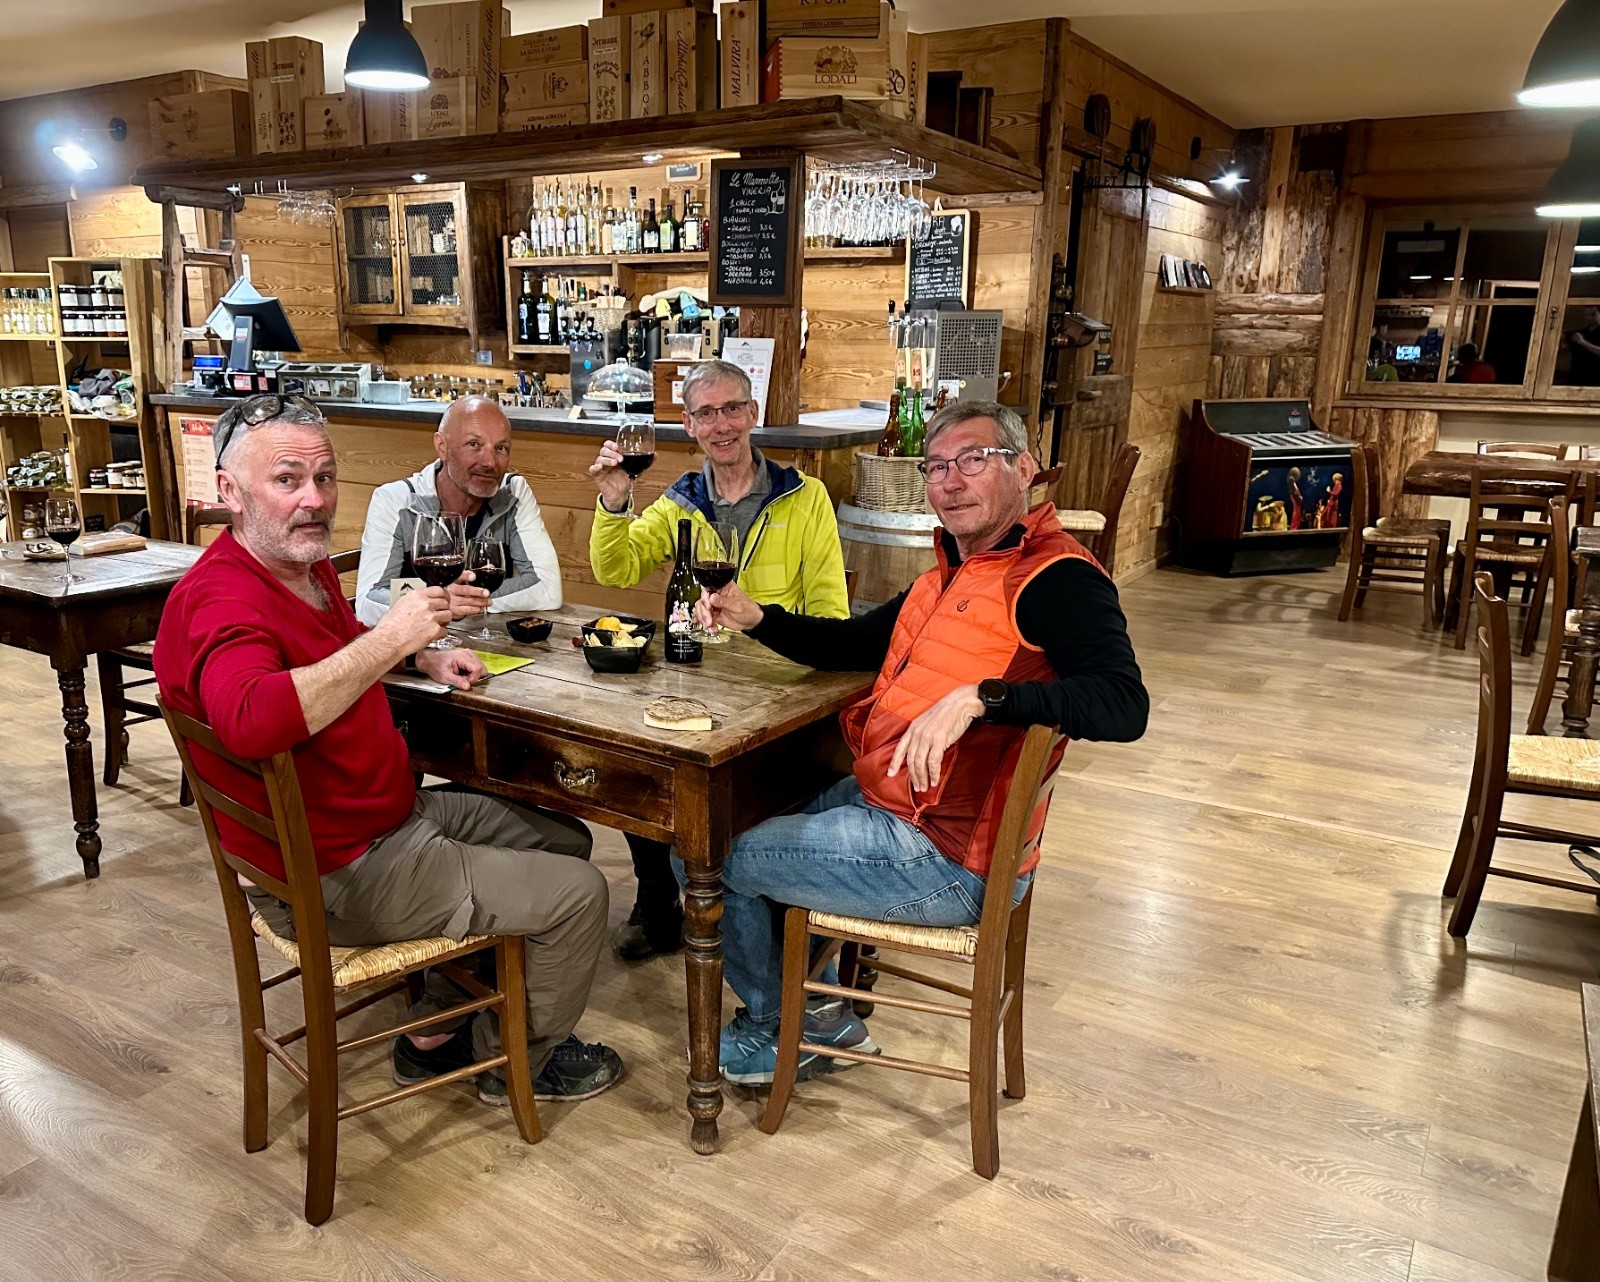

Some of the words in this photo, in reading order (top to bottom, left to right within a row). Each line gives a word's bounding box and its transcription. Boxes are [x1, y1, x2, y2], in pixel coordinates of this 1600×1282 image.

[732, 35, 742, 98] MALVIRA'
[814, 74, 858, 85] LODALI
[741, 186, 772, 196] VINERIA
